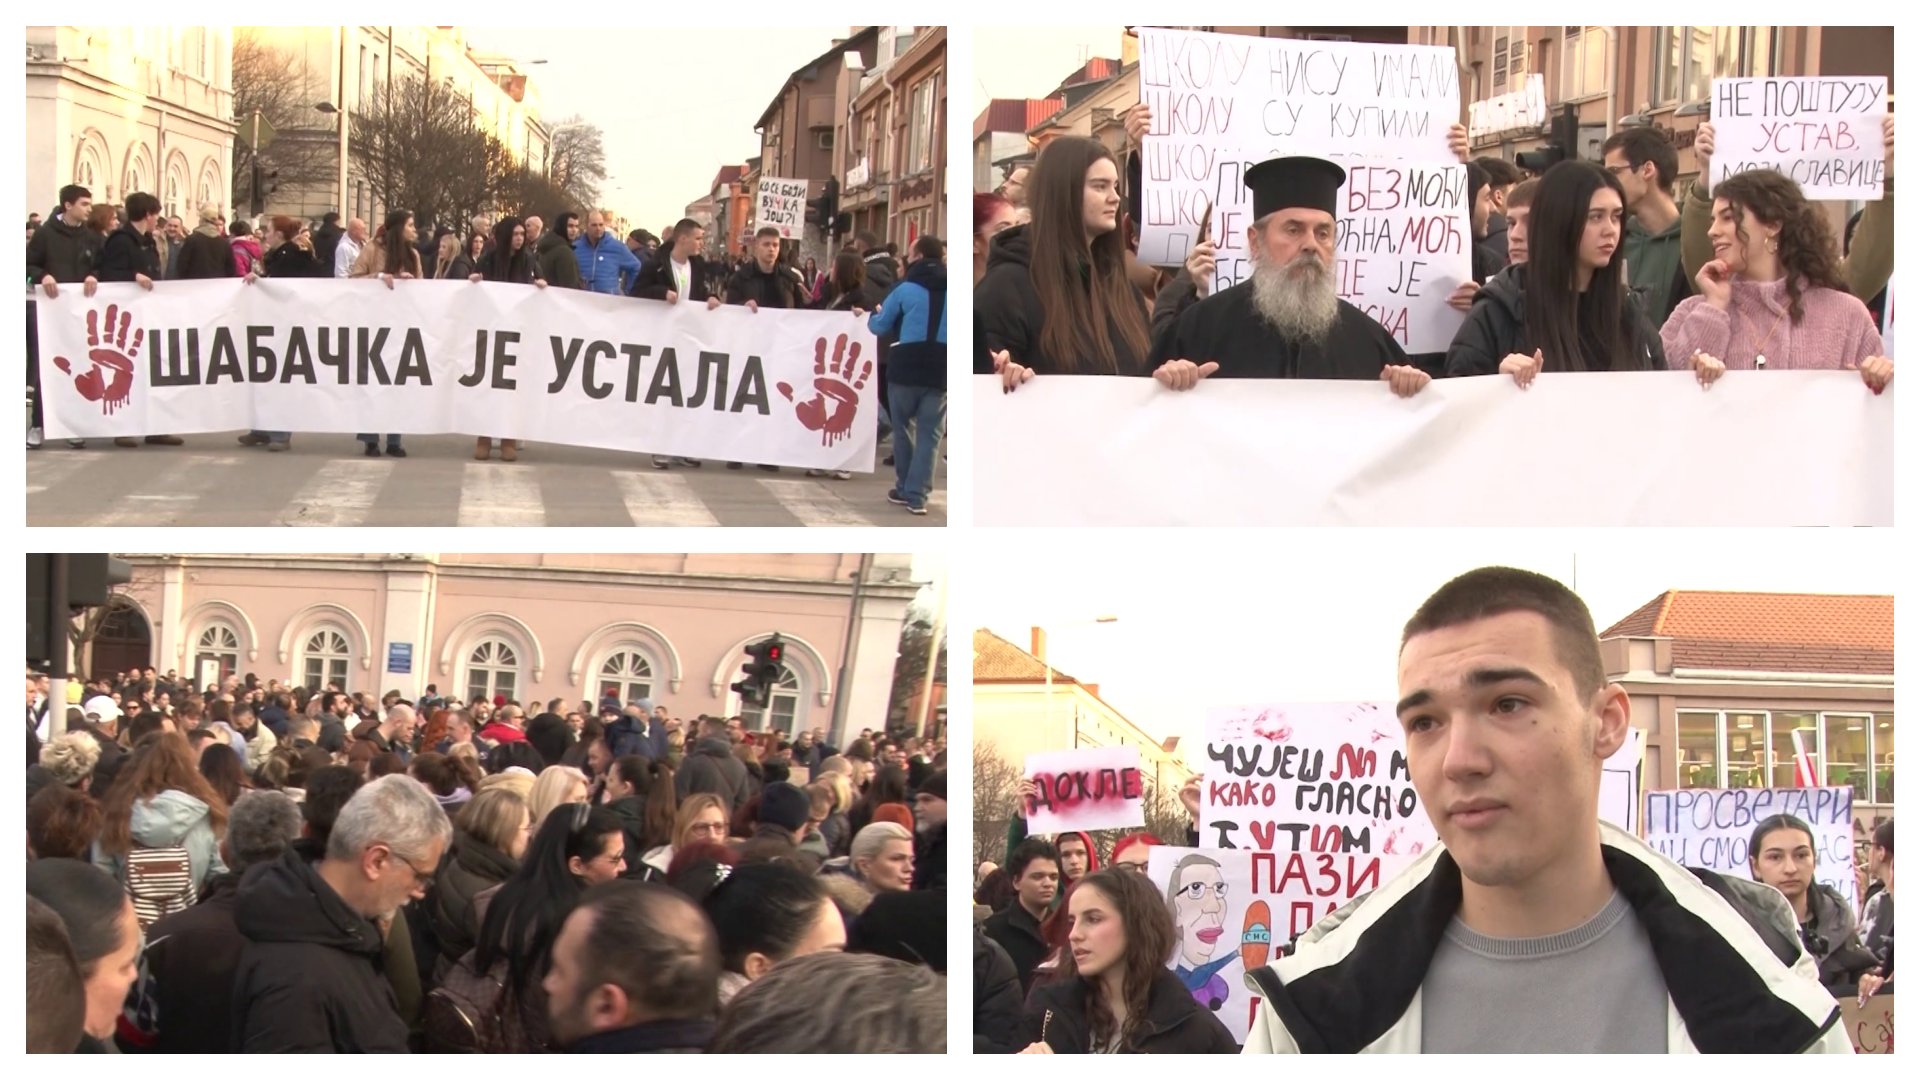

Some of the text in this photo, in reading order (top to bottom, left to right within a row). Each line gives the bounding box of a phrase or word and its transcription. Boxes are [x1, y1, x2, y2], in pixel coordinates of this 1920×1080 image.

[1142, 33, 1251, 89] ШКОЛУ
[1268, 48, 1348, 96] НИСУ
[1373, 50, 1459, 100] ИМАЛИ
[1146, 90, 1235, 136] ШКОЛУ
[1262, 99, 1304, 136] СУ
[1331, 102, 1429, 138] КУПИЛИ
[1719, 80, 1884, 118] НЕ ПОШТУЈУ
[1752, 121, 1861, 153] УСТАВ,
[1348, 165, 1468, 213] БЕЗ МОЋИ
[1213, 211, 1242, 251] ЈЕ
[1398, 215, 1462, 255] МОЋ
[1387, 259, 1428, 298] ЈЕ
[148, 325, 771, 415] ШАБАЧКА ЈЕ УСТАЛА
[1207, 743, 1324, 782] ЧУЈЕШ
[1329, 743, 1377, 781] ЛИ
[1029, 766, 1139, 814] ДОКЛЕ
[1209, 779, 1417, 820] КАКО ГЛАСНО
[1700, 836, 1748, 869] СМО
[1251, 853, 1380, 898] ПАЗИ
[1244, 933, 1269, 942] СНС
